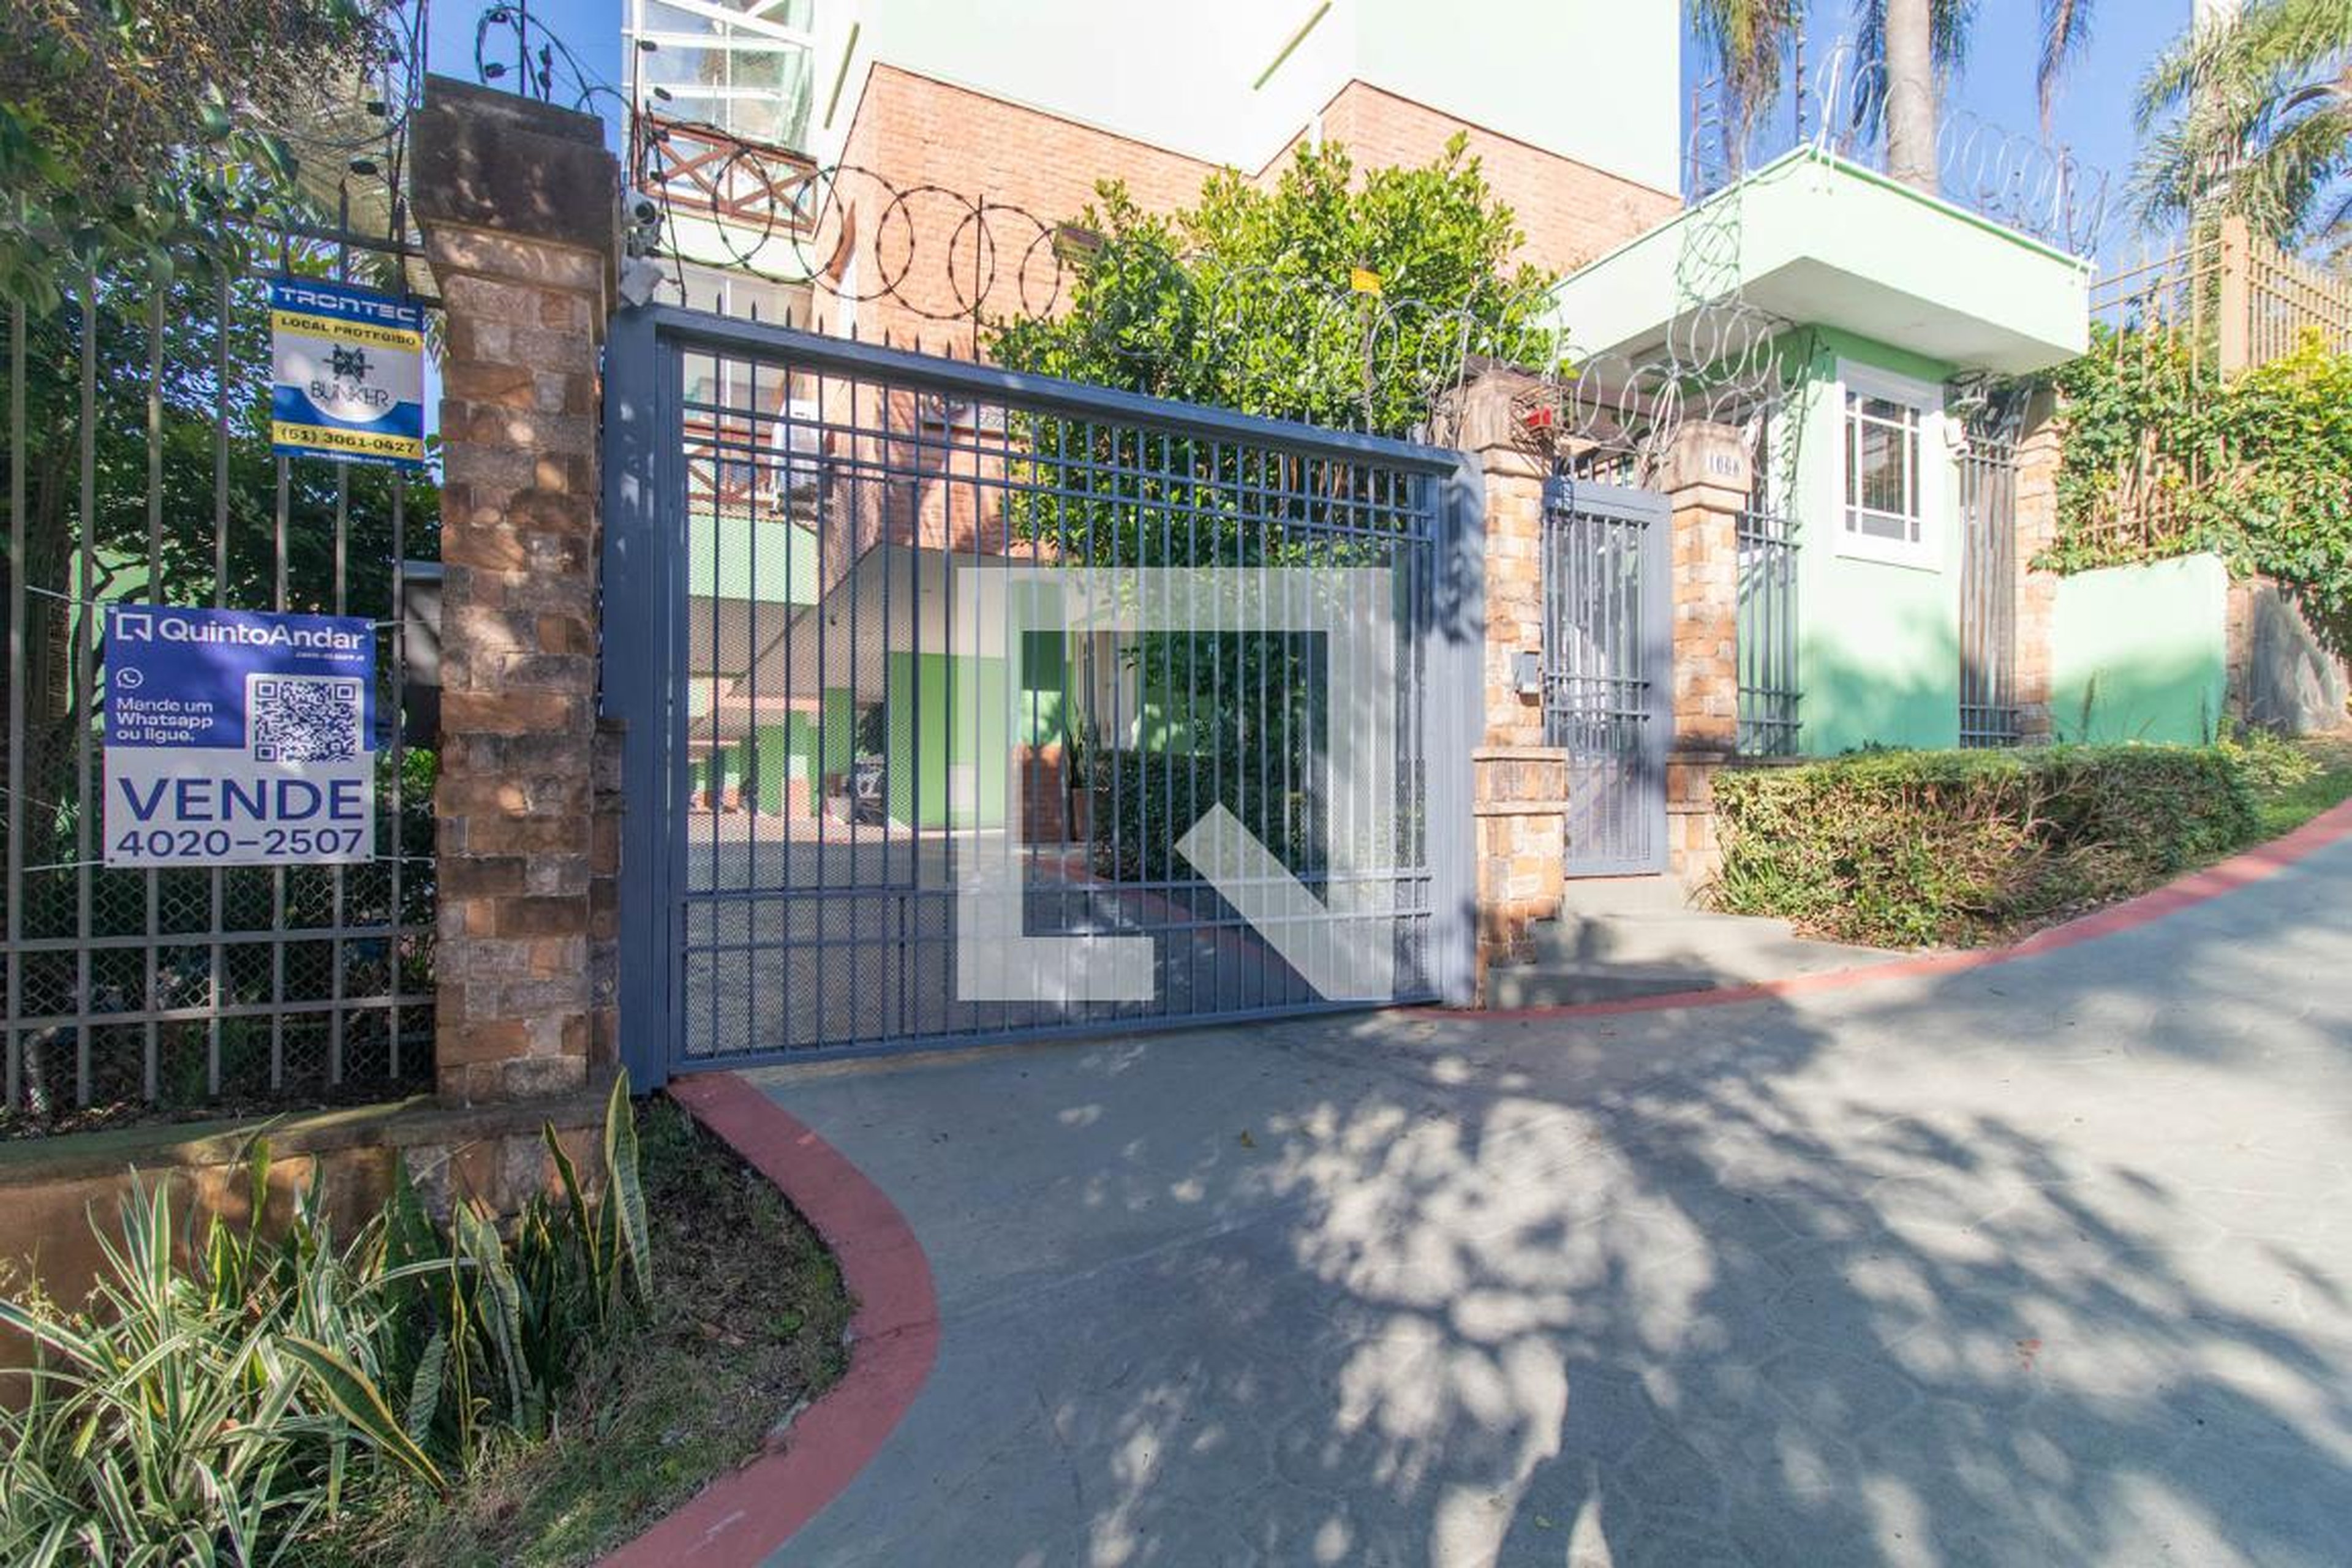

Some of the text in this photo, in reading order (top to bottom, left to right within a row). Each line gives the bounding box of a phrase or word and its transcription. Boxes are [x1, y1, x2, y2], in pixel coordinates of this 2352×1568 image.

[277, 287, 417, 322] TRONTEC
[281, 317, 416, 346] LOCAL PROTEGIDO
[311, 380, 389, 407] BUNKER
[281, 428, 317, 442] (51)
[159, 617, 366, 649] QuintoAndar
[116, 698, 213, 713] Mande um
[116, 712, 213, 729] Whatsapp
[116, 729, 140, 740] ou
[118, 777, 363, 821] VENDE
[116, 829, 363, 856] 4020-2507
